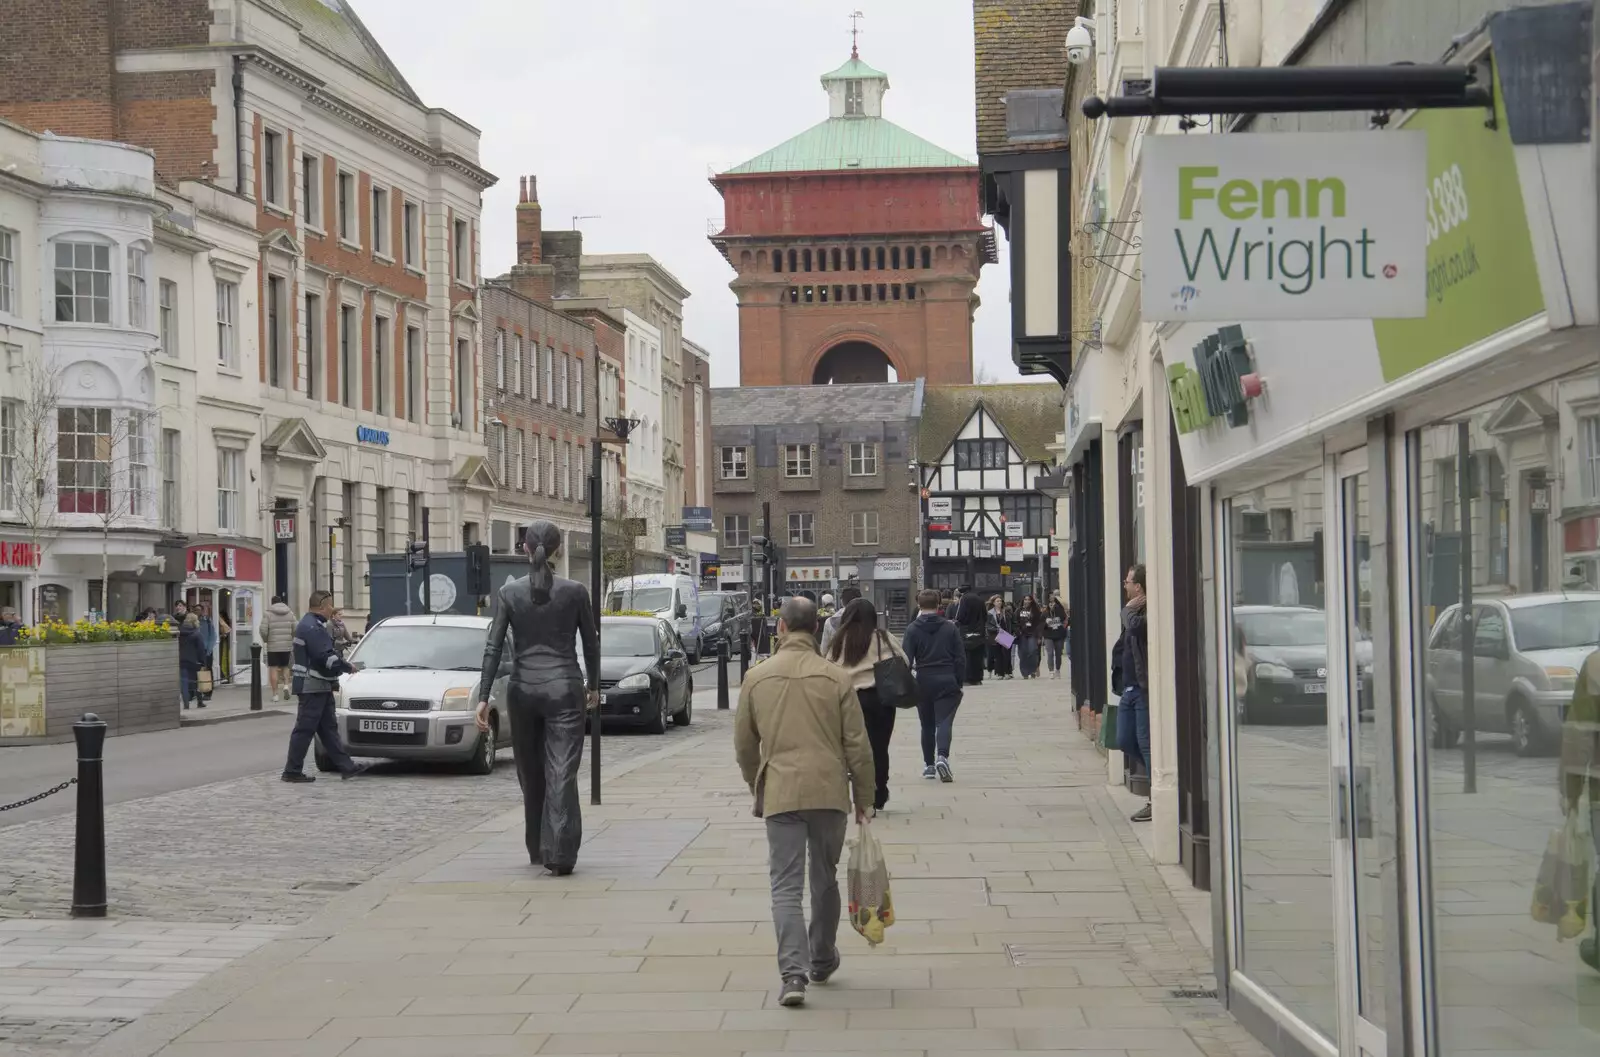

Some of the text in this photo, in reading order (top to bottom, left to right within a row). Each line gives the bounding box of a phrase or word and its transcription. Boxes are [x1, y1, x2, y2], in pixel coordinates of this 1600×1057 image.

[1178, 166, 1346, 220] Fenn
[195, 550, 218, 572] KFC
[363, 720, 410, 731] BT06 EEV
